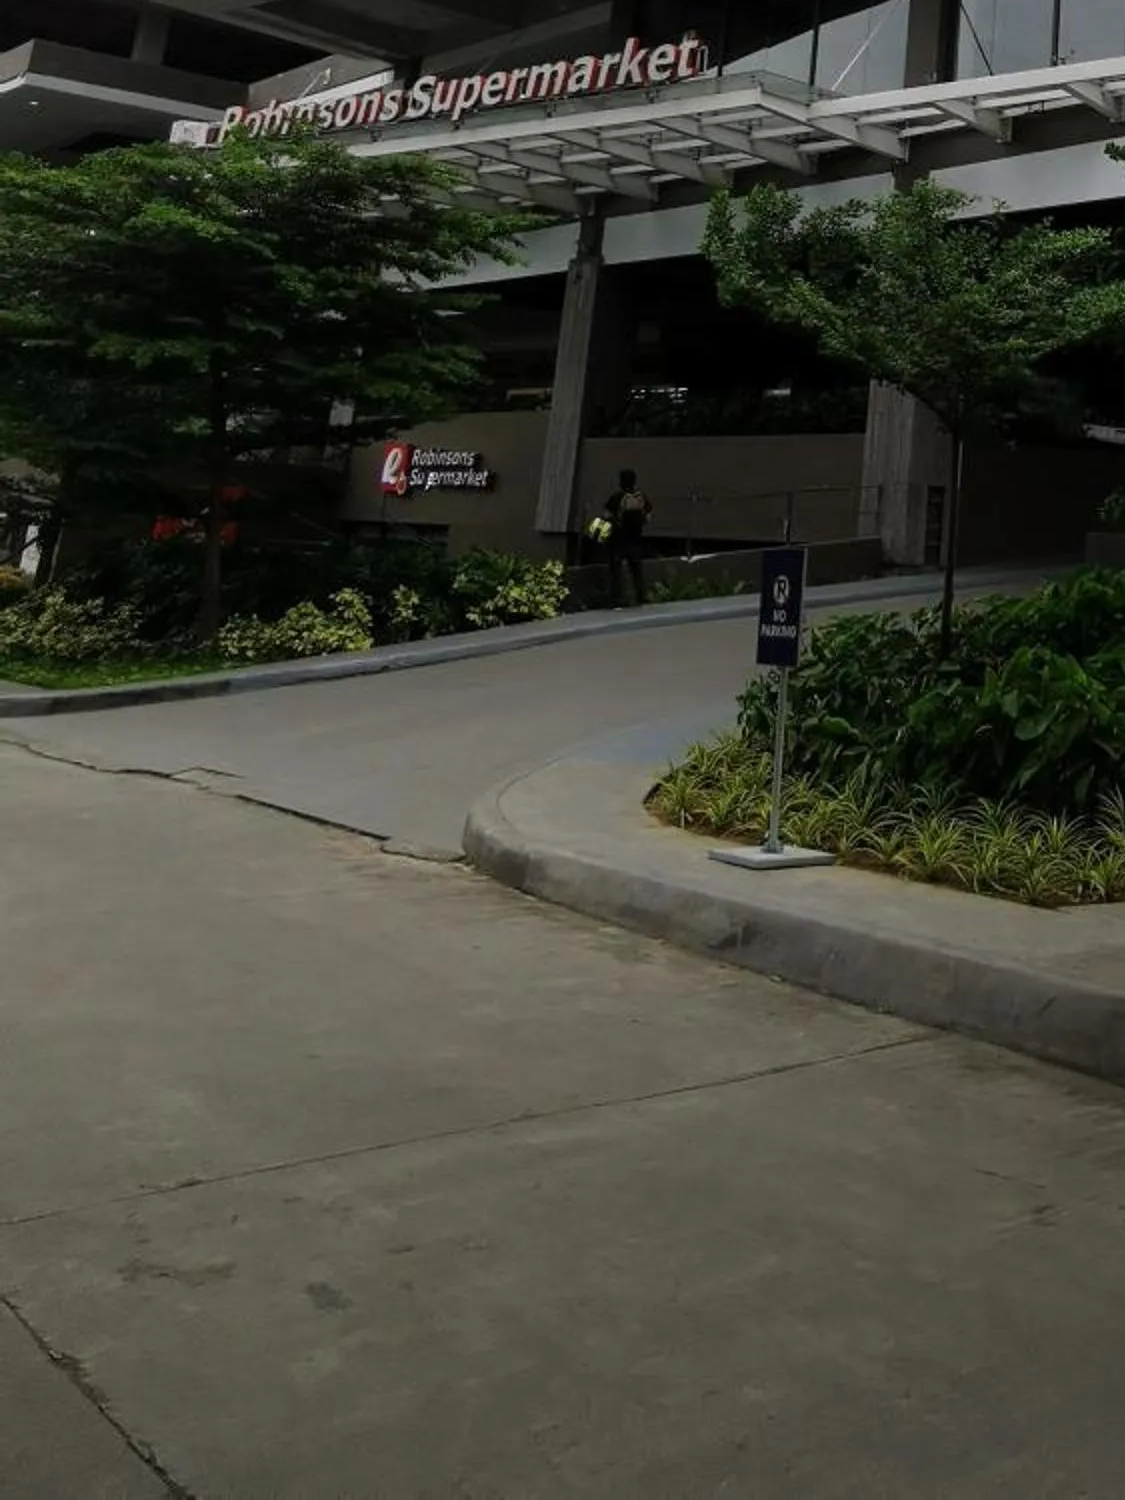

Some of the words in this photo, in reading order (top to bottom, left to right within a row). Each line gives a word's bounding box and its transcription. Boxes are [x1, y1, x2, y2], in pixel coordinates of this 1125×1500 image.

[405, 35, 702, 121] Supermarket
[411, 449, 476, 467] Robinsons
[409, 468, 489, 492] Supermarket
[773, 608, 787, 622] NO
